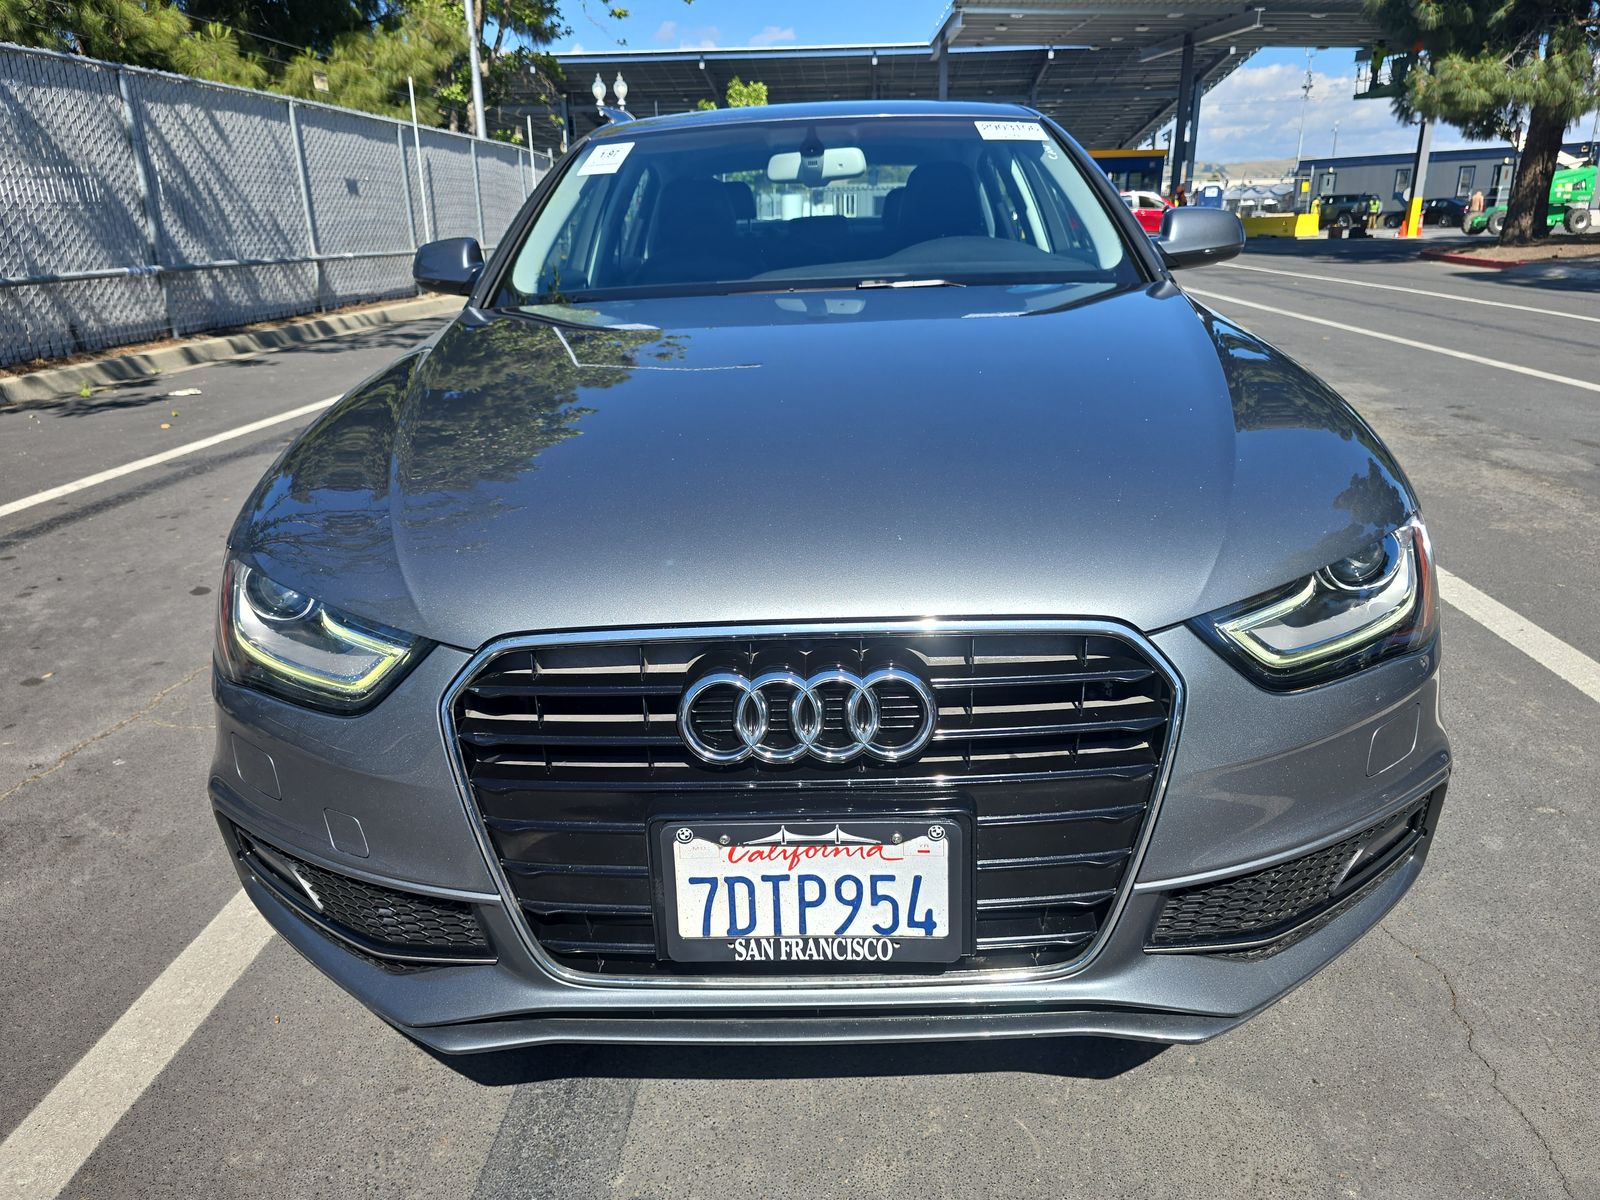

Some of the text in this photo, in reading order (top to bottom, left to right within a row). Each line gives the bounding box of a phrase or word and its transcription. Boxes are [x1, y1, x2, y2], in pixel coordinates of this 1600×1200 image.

[728, 844, 902, 871] California
[689, 874, 938, 937] 7DTP954
[735, 938, 893, 961] SAN FRANCISCO
